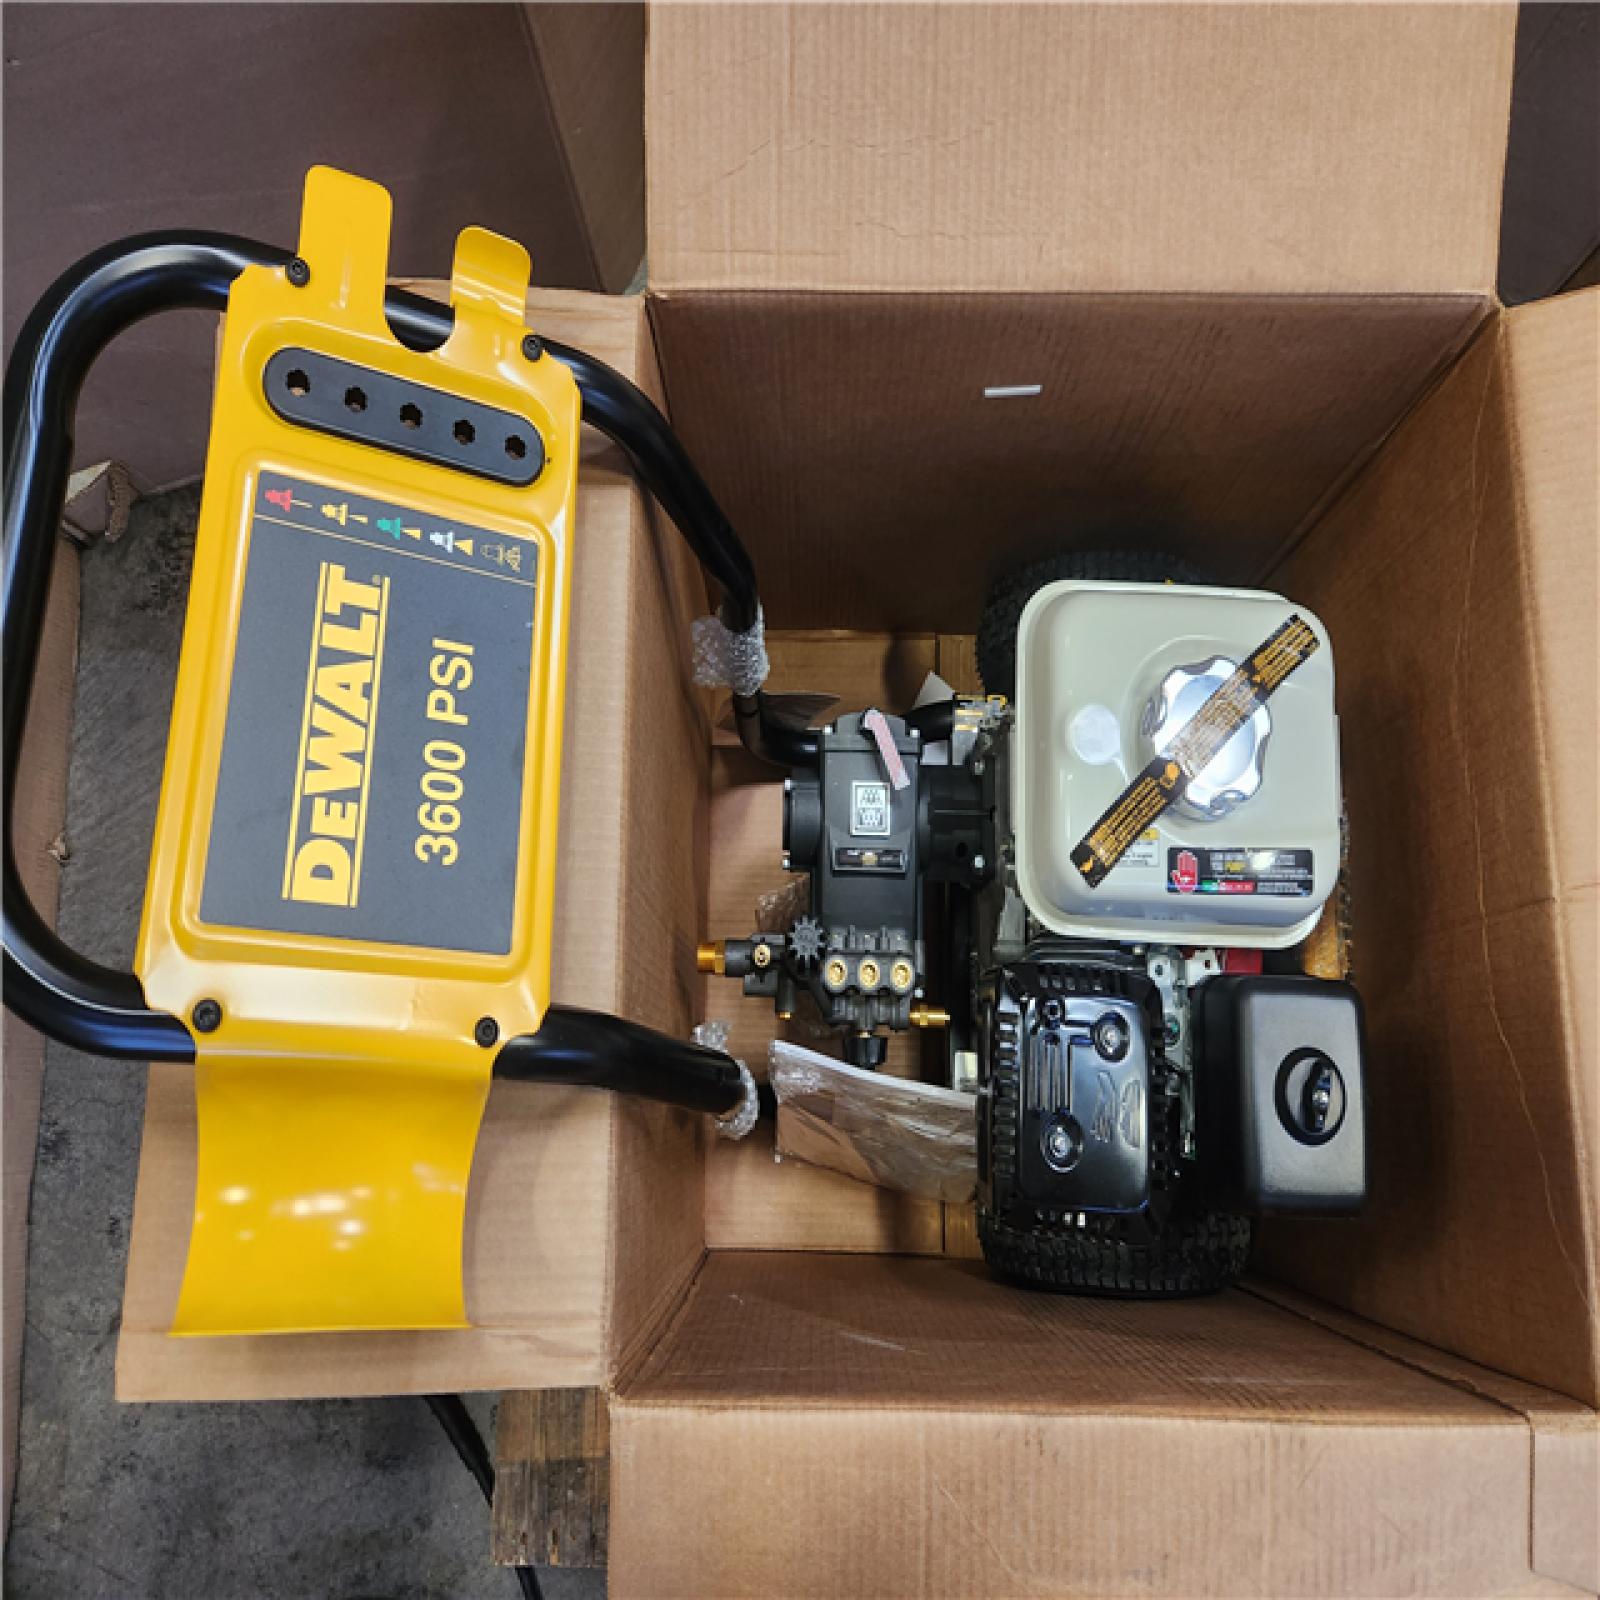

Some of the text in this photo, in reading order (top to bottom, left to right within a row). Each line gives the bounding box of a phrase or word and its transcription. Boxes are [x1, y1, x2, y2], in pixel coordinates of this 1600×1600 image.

[290, 563, 382, 906] DEWALT
[414, 637, 475, 866] 3600 PSI
